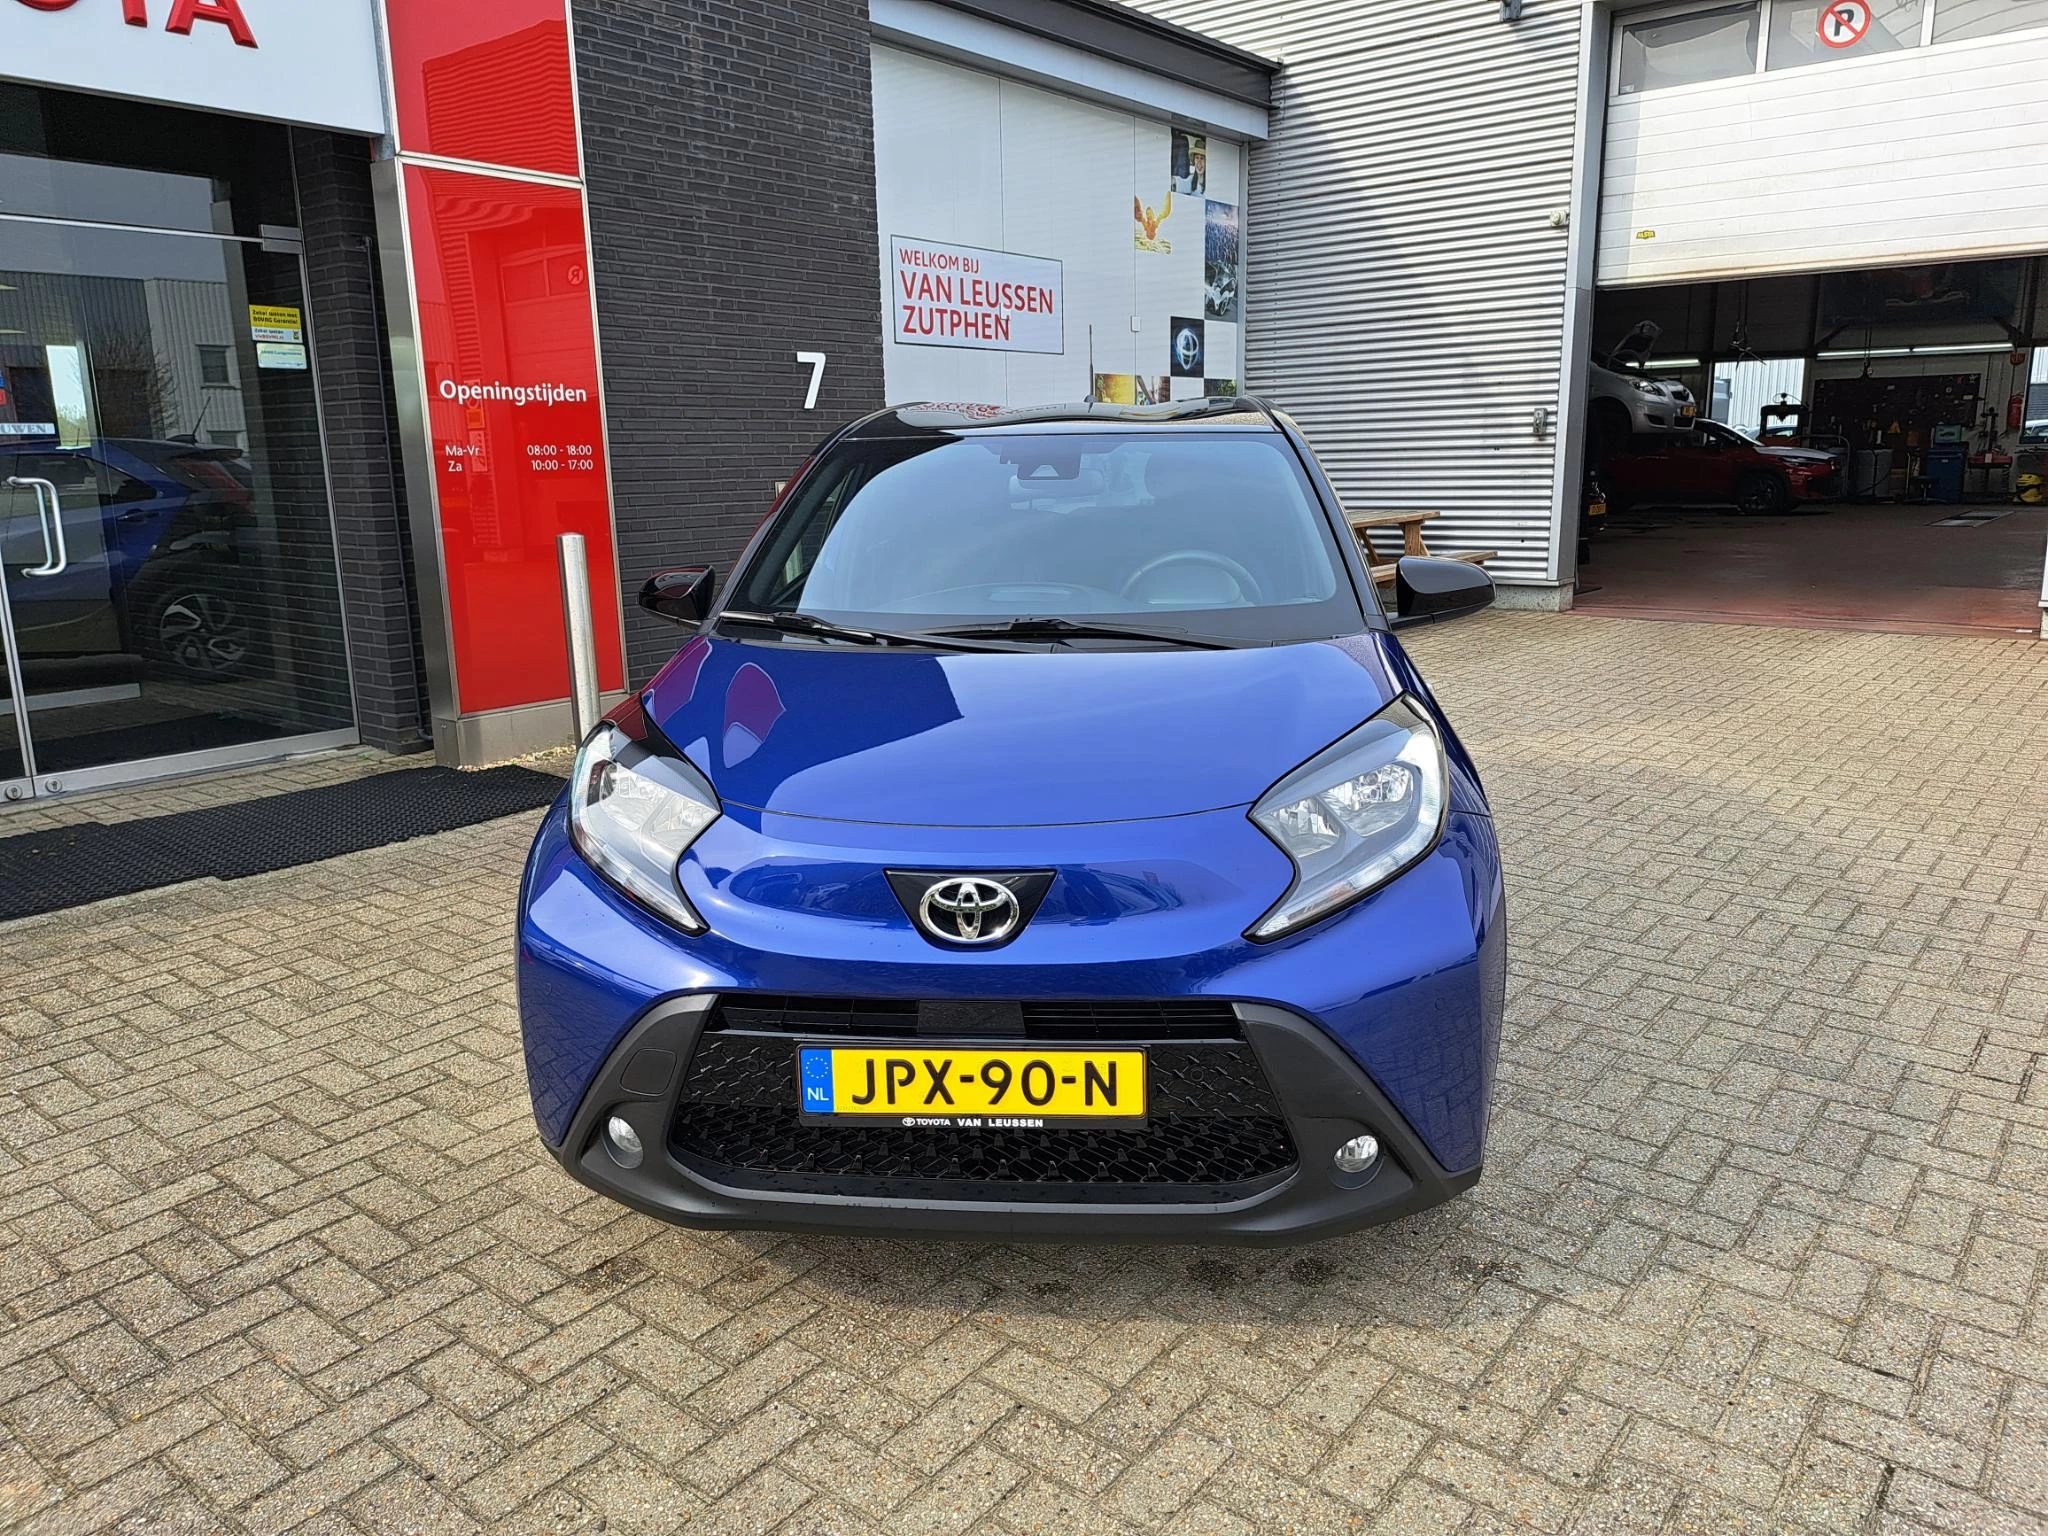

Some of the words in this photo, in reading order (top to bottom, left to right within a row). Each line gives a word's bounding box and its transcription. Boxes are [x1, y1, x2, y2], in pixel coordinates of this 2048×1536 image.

[1834, 9, 1855, 37] P
[899, 248, 959, 271] WELKOM
[963, 257, 979, 274] BIJ
[900, 270, 952, 303] VAN
[960, 277, 1053, 315] LEUSSEN
[902, 305, 1010, 341] ZUTPHEN
[439, 379, 587, 407] Openingstijden
[796, 351, 826, 409] 7
[445, 444, 480, 456] Ma-Vr
[527, 444, 557, 456] 08:00
[566, 444, 592, 456] 18:00
[448, 460, 463, 472] Za
[531, 459, 559, 471] 10:00
[568, 459, 594, 471] 17:00
[807, 1087, 830, 1101] NL
[851, 1058, 1118, 1106] JPX-90-N
[916, 1118, 951, 1126] TOYOTA
[957, 1118, 982, 1127] VAN
[988, 1118, 1044, 1128] LEUSSEN
